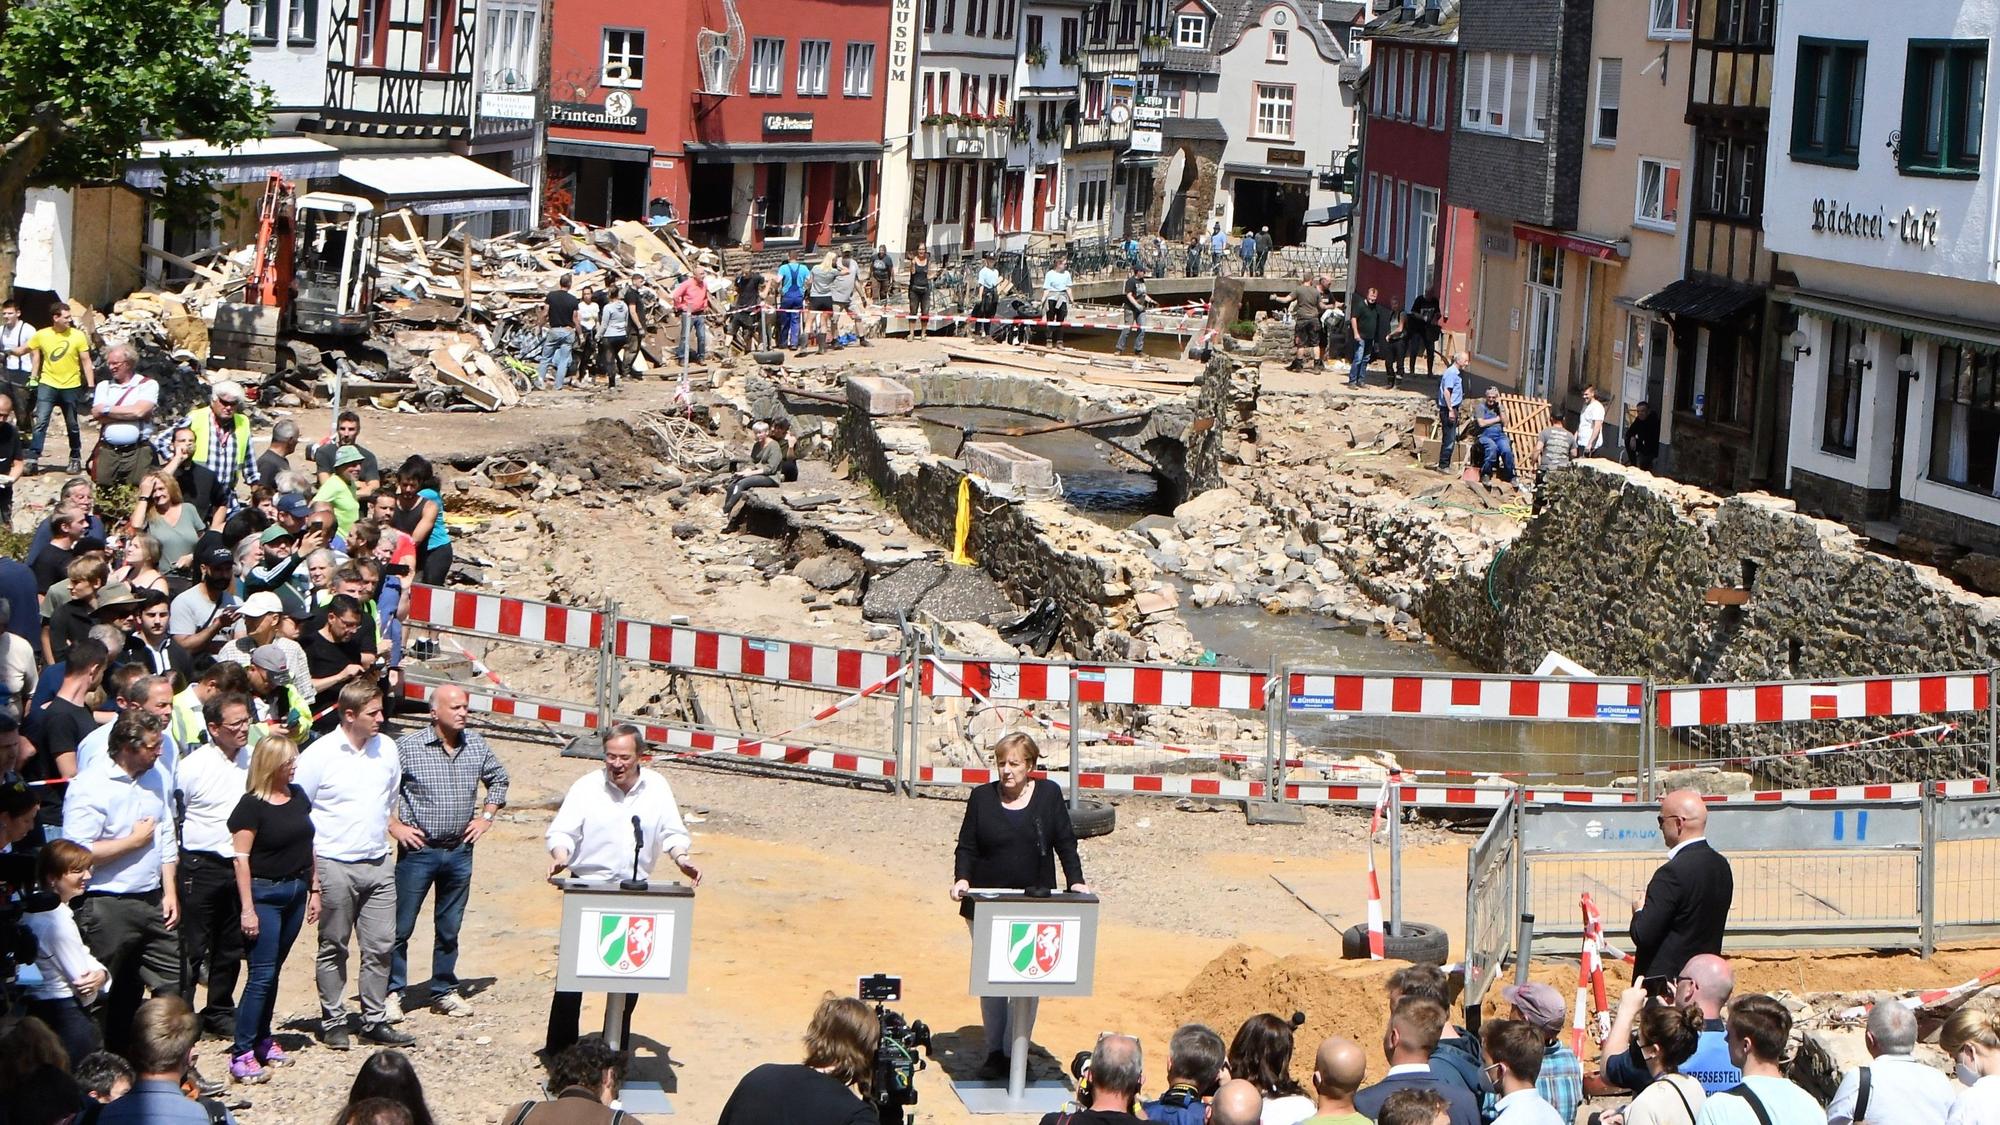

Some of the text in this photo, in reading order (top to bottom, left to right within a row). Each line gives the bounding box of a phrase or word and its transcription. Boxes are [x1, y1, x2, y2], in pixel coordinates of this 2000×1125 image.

[890, 0, 910, 82] MUSEUM
[550, 104, 638, 126] Printenhaus
[1811, 197, 1884, 240] Bäckerei
[1901, 206, 1939, 251] Café
